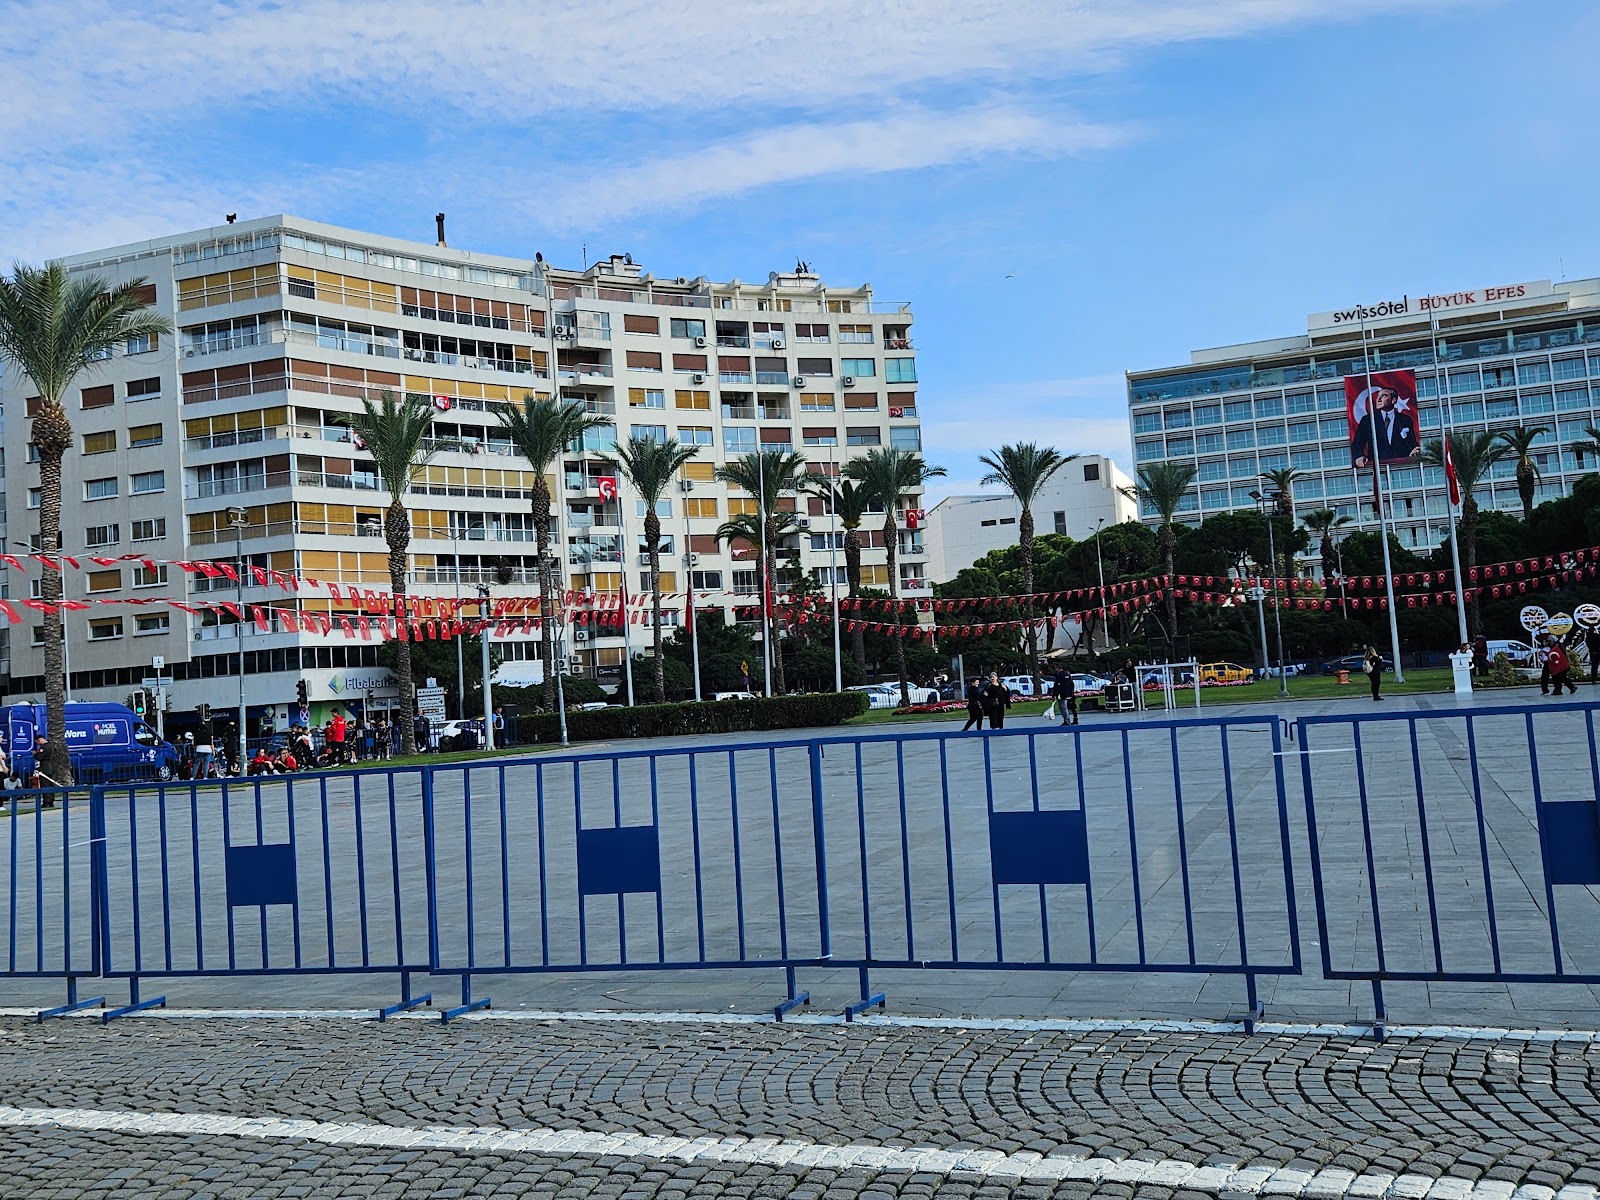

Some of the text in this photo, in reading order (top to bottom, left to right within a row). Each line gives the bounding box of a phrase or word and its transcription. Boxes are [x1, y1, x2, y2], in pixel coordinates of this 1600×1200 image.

[1333, 285, 1526, 323] swissôtel BÜYÜK EFES
